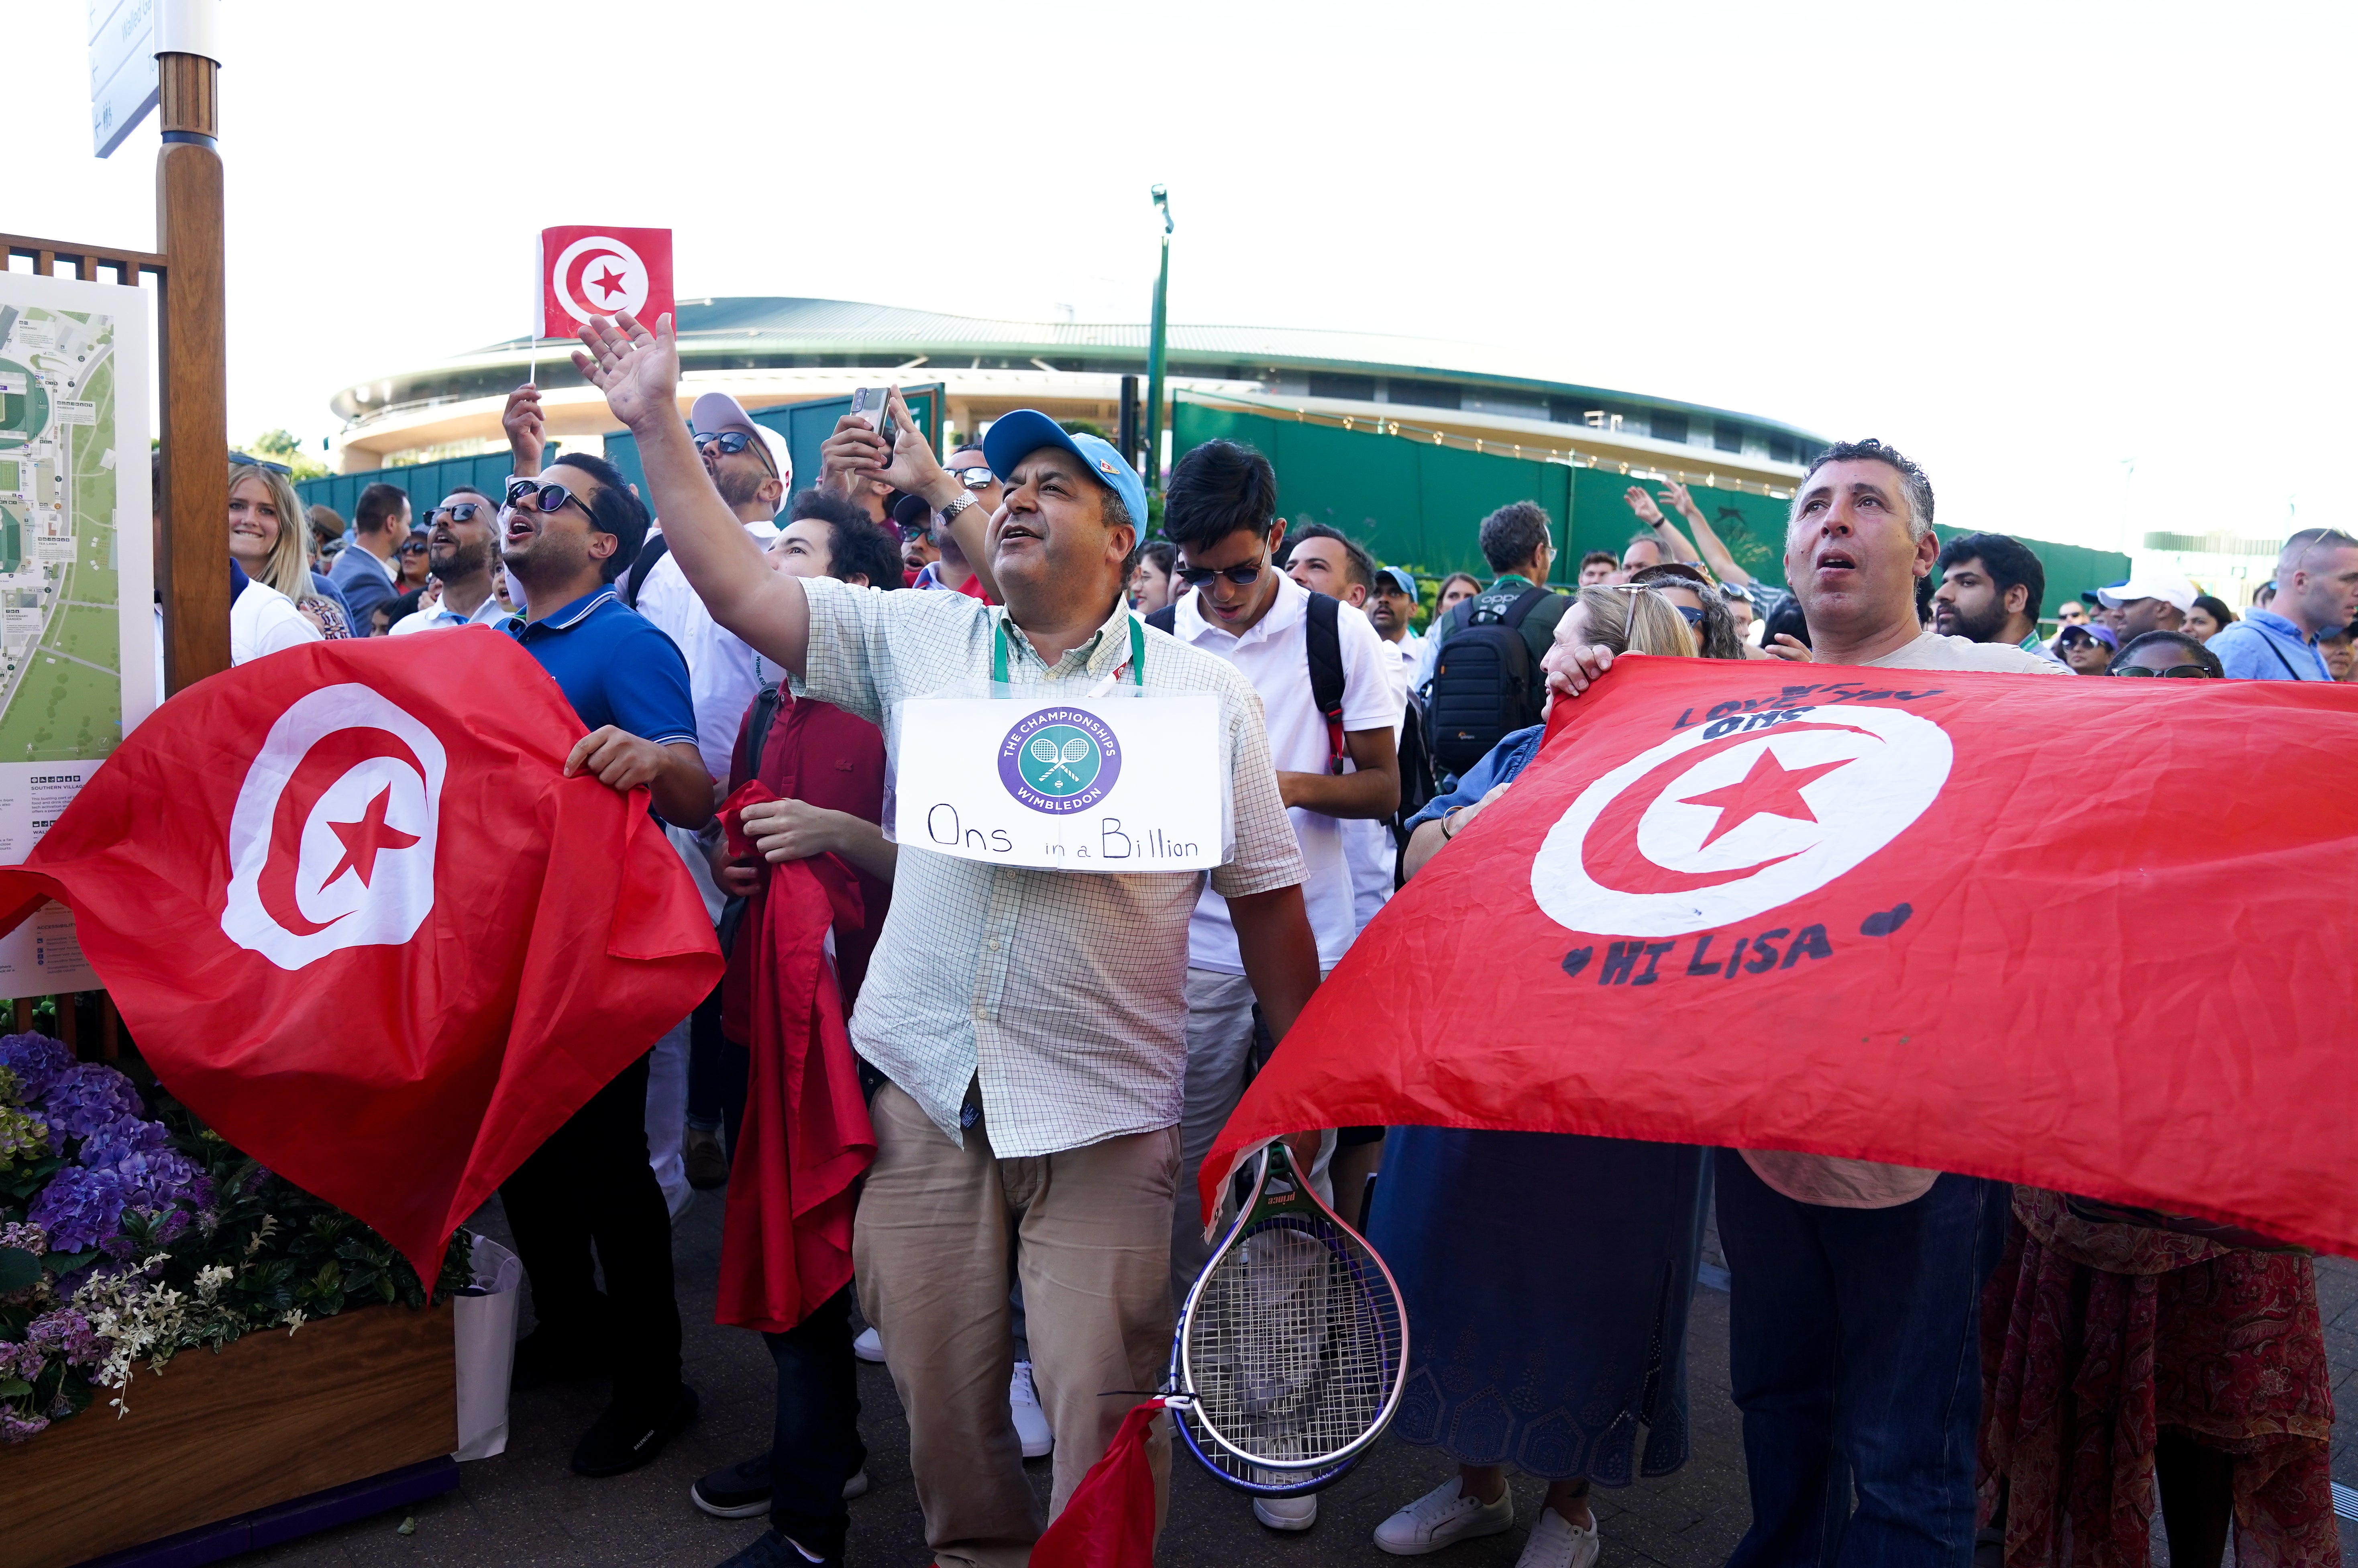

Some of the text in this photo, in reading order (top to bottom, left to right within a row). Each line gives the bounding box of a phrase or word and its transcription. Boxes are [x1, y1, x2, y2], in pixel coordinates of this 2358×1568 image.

[121, 0, 141, 42] Walled
[1671, 694, 1809, 730] LOVE
[1702, 706, 1816, 740] ONS
[1003, 710, 1117, 758] THE CHAMPIONSHIPS
[1017, 786, 1102, 811] WIMBLEDON
[927, 803, 1198, 858] Ons in a Billion
[1599, 923, 1833, 986] HI LISA
[1268, 1191, 1296, 1205] prince
[633, 1429, 655, 1451] BALENCIAGA
